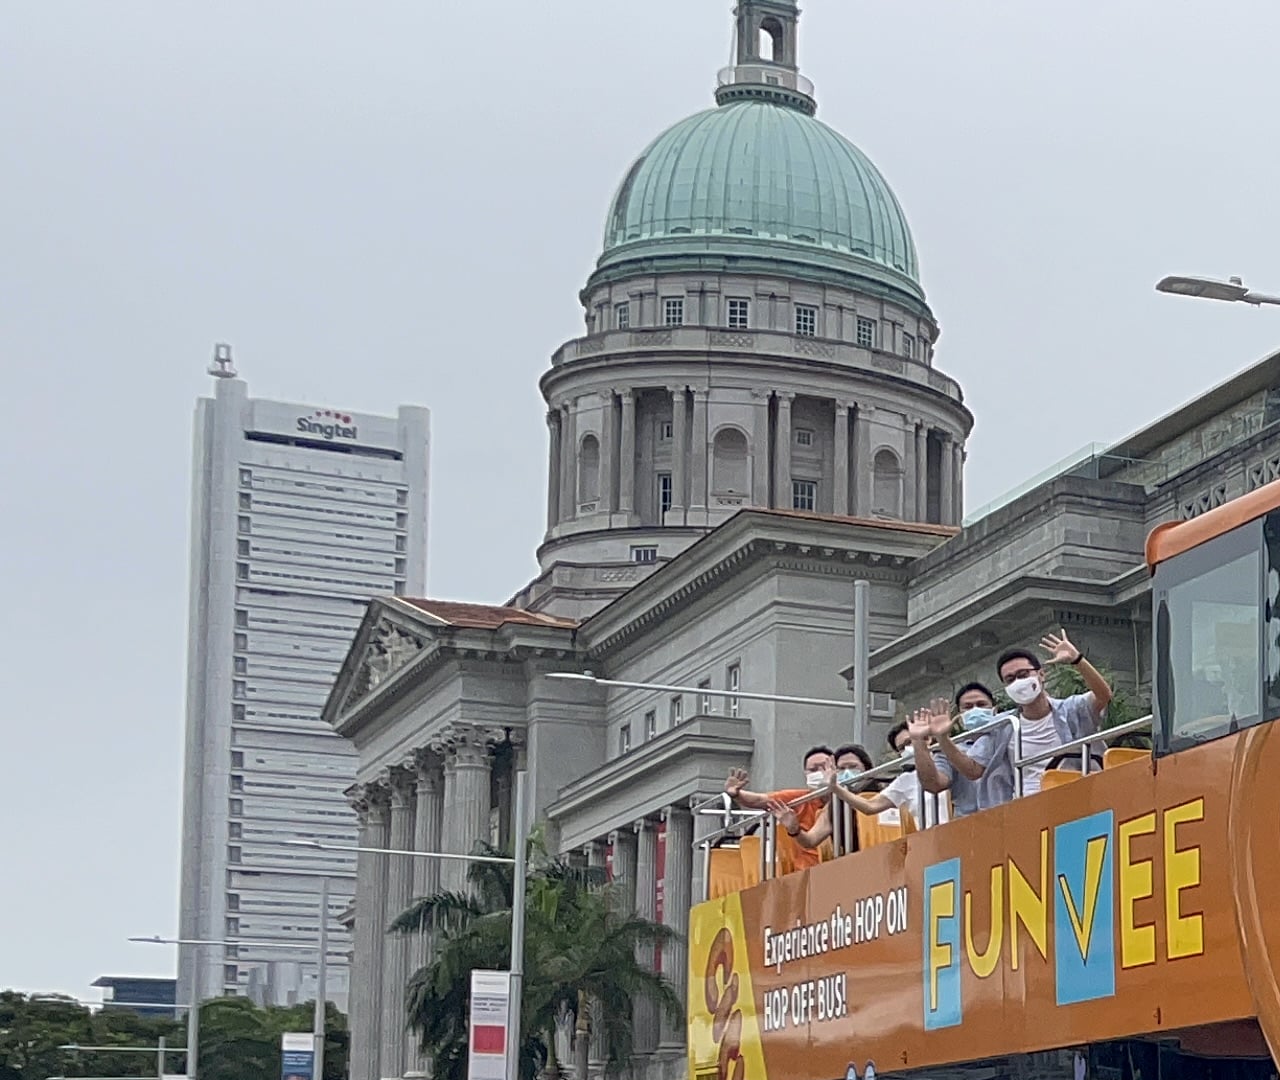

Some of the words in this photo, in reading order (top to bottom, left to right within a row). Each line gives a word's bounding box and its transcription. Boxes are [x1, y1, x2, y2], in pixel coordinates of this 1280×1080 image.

[296, 416, 357, 440] Singtel
[763, 918, 829, 974] Experience
[831, 904, 852, 950] the
[855, 894, 884, 944] HOP
[886, 887, 908, 935] ON
[928, 796, 1205, 1013] FUNVEE
[763, 987, 789, 1031] HOP
[791, 981, 815, 1026] OFF
[817, 973, 847, 1021] BUS!
